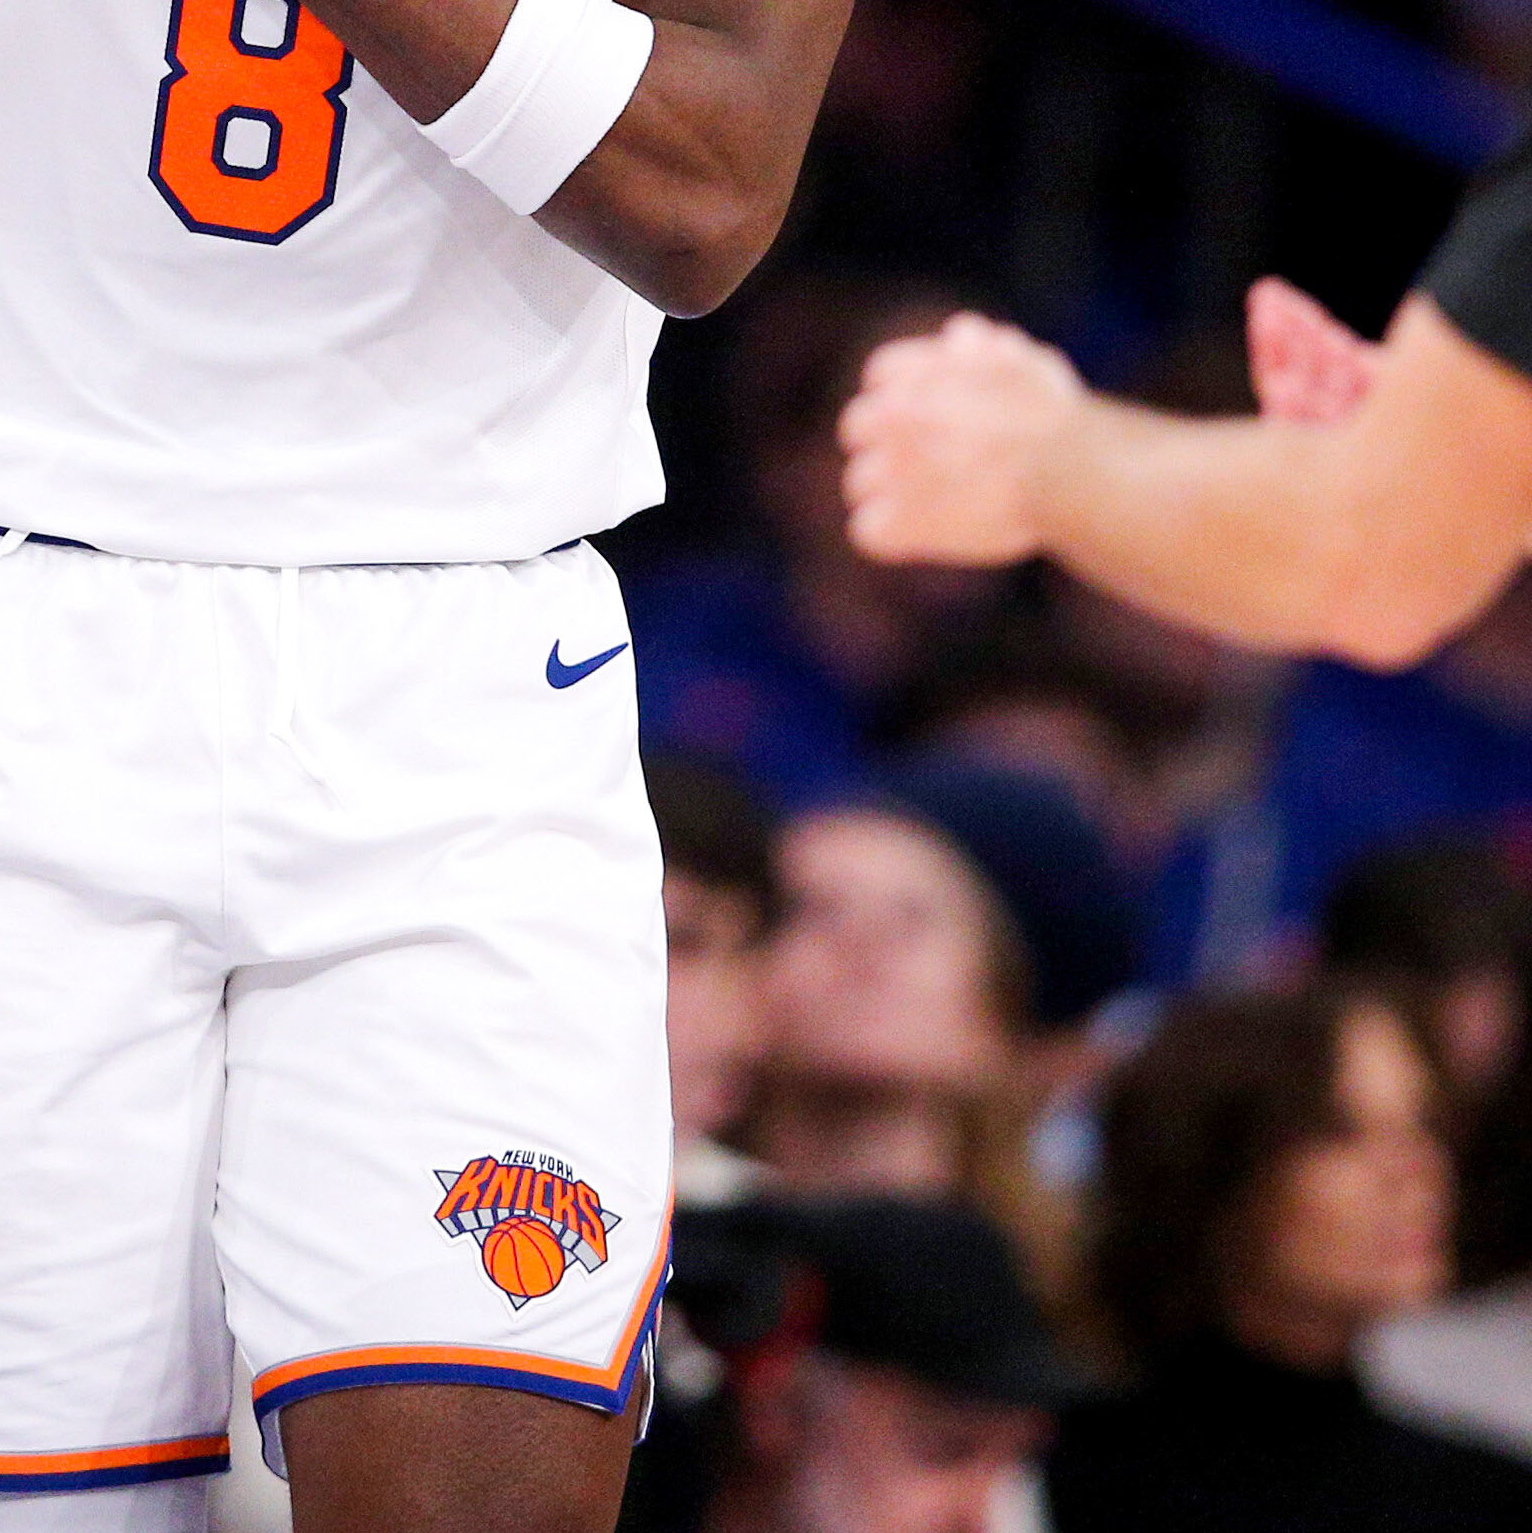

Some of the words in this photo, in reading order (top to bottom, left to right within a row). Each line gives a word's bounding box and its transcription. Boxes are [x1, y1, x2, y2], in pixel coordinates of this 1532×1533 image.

[501, 1149, 535, 1165] NEW
[539, 1153, 574, 1183] YORK
[433, 1154, 608, 1264] KNICKS
